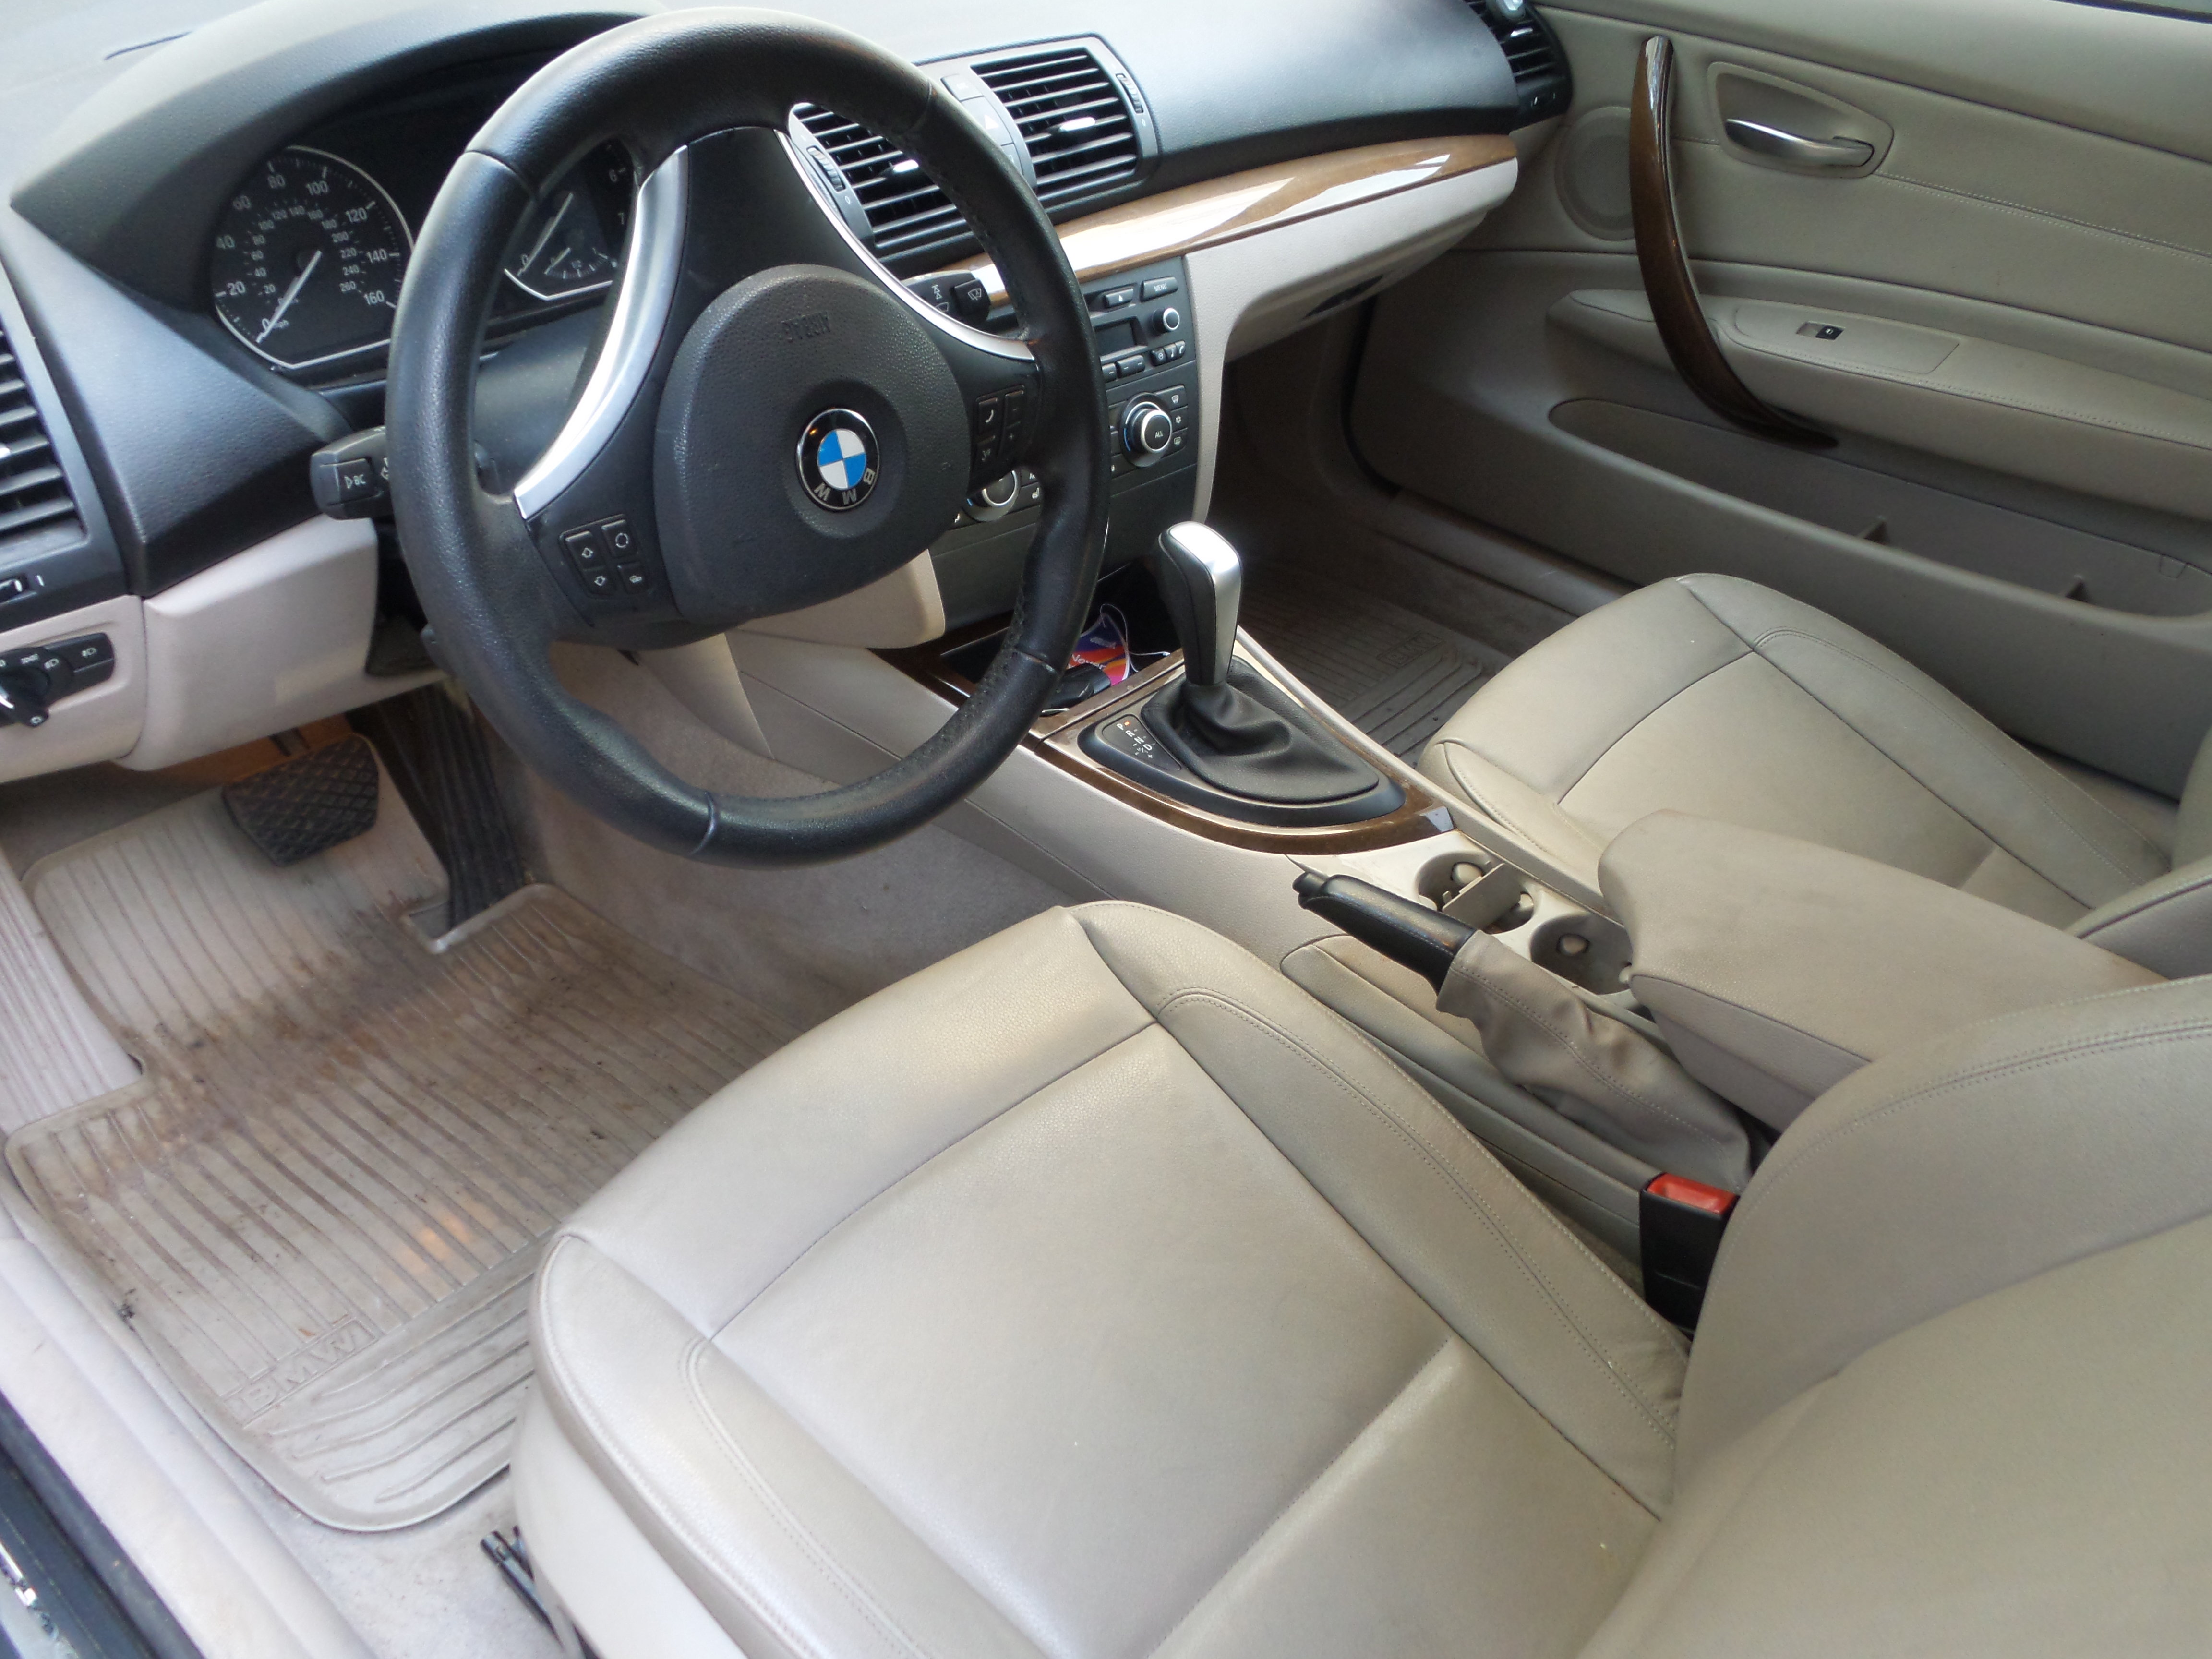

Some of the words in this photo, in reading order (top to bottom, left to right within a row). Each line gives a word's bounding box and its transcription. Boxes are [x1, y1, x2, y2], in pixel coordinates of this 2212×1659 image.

[267, 174, 286, 189] 80
[305, 180, 328, 196] 100
[345, 208, 368, 223] 120
[216, 234, 236, 249] 40
[340, 247, 358, 259] 220
[366, 248, 387, 264] 140
[342, 264, 360, 276] 240
[227, 280, 246, 296] 20
[263, 283, 276, 294] 20
[1154, 283, 1167, 291] MENU
[363, 290, 385, 306] 160
[814, 467, 876, 505] BMW
